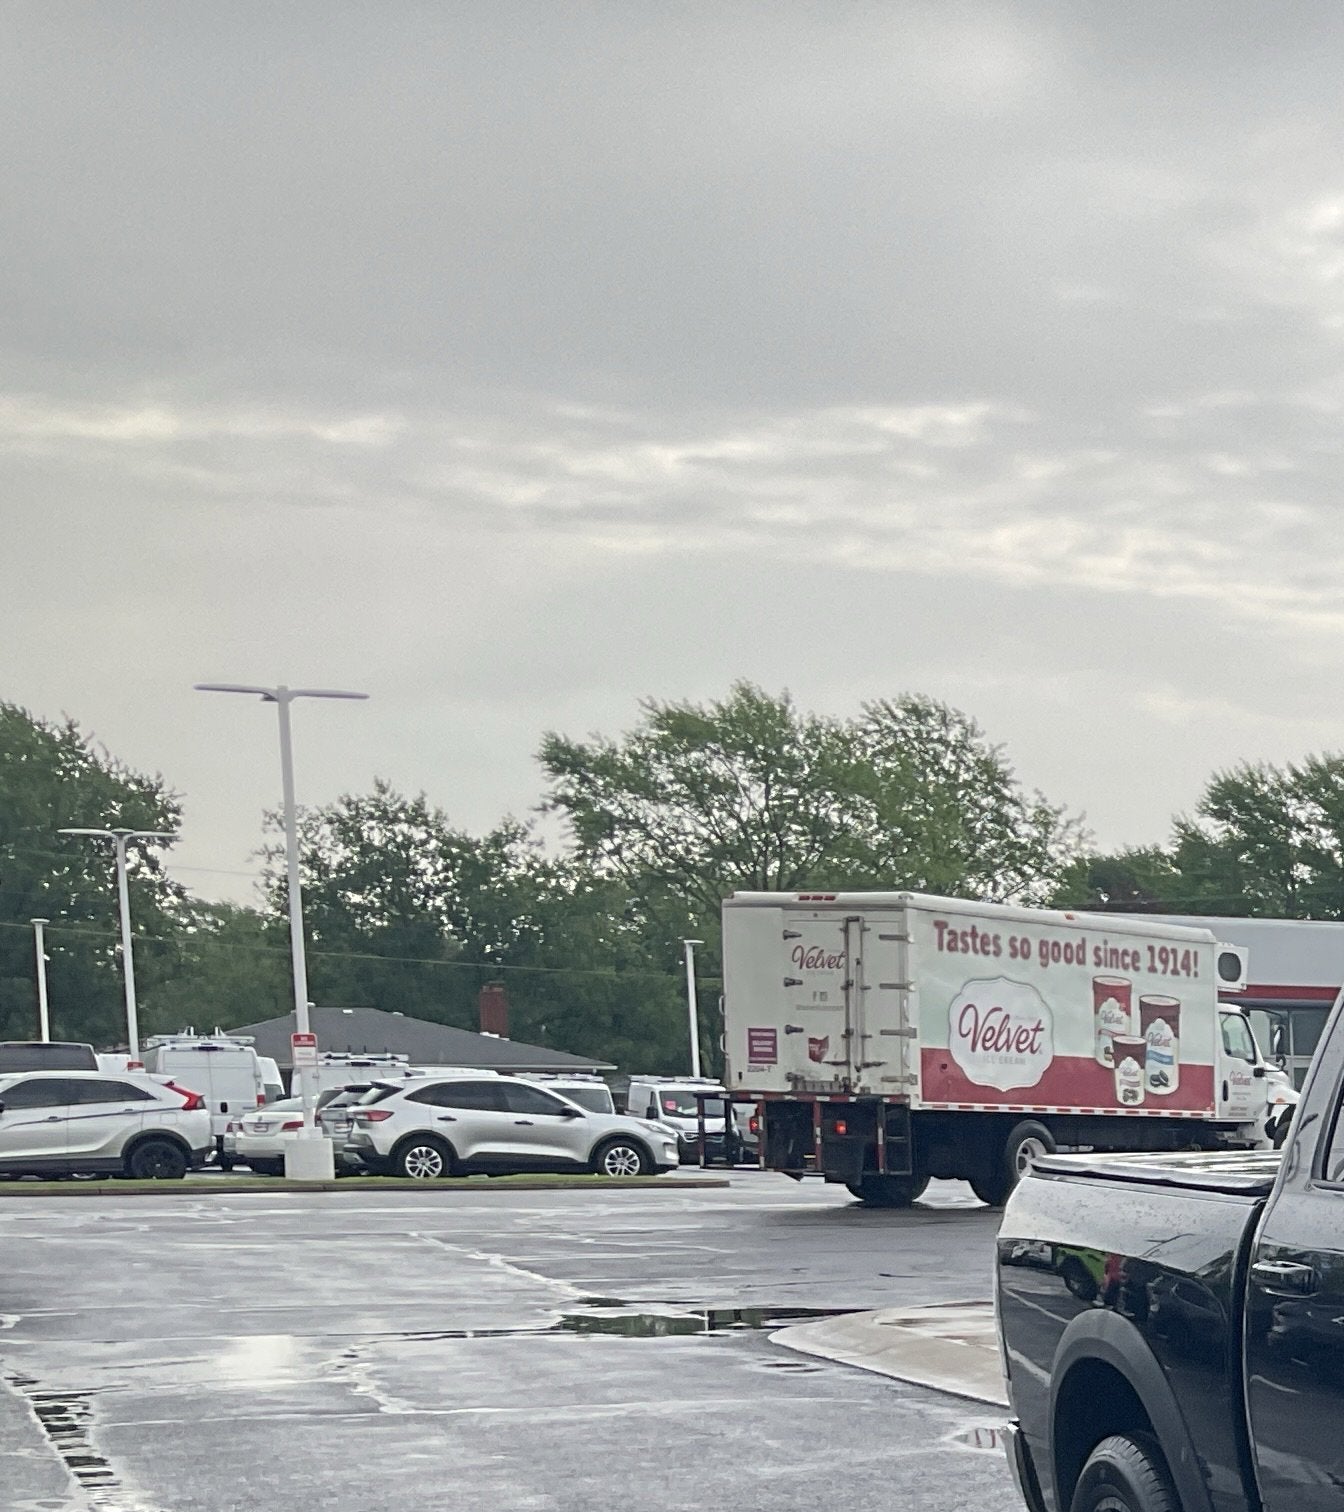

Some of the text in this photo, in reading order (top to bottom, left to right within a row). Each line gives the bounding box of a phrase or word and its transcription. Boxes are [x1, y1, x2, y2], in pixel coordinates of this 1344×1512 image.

[791, 944, 847, 969] Velvet
[933, 920, 1199, 978] Tastes so good since 1914!
[959, 1003, 1045, 1055] Velvet
